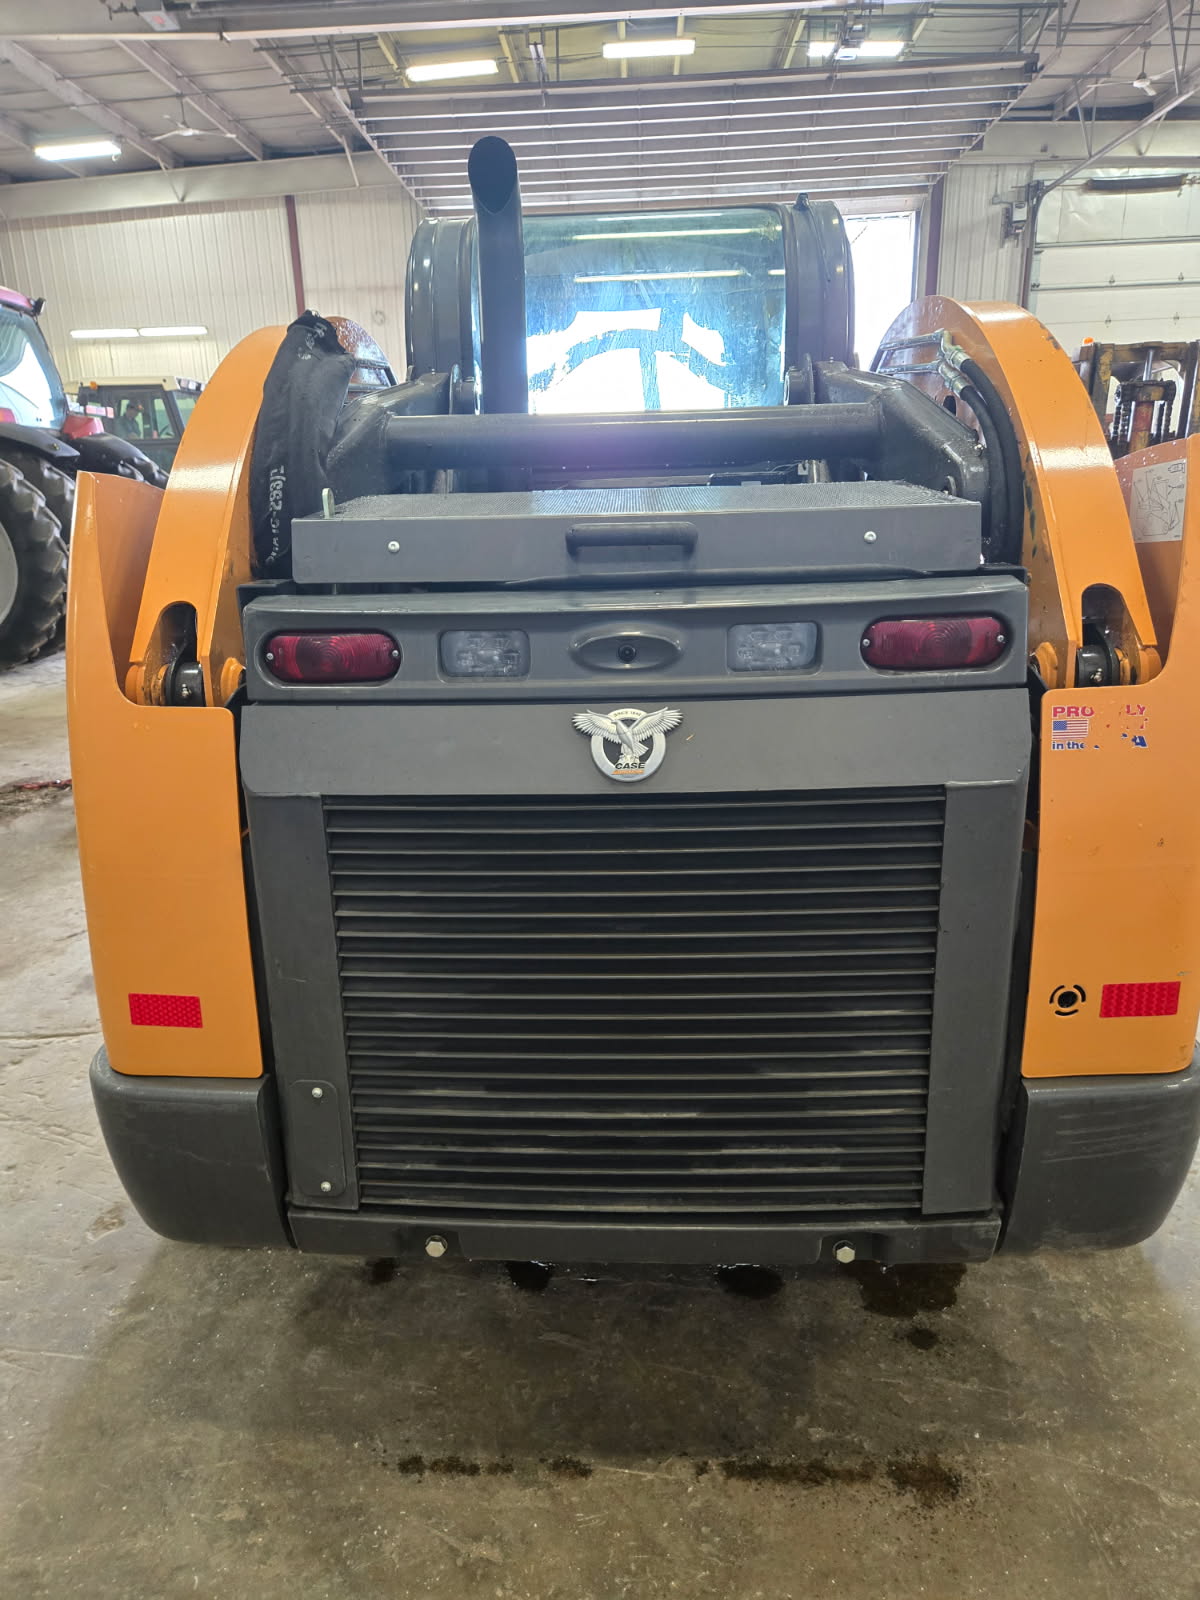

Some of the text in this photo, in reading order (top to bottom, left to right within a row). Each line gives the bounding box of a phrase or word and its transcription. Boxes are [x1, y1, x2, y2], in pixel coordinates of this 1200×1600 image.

[1052, 704, 1146, 718] PROLY
[1052, 741, 1064, 750] in
[615, 762, 646, 770] CASE
